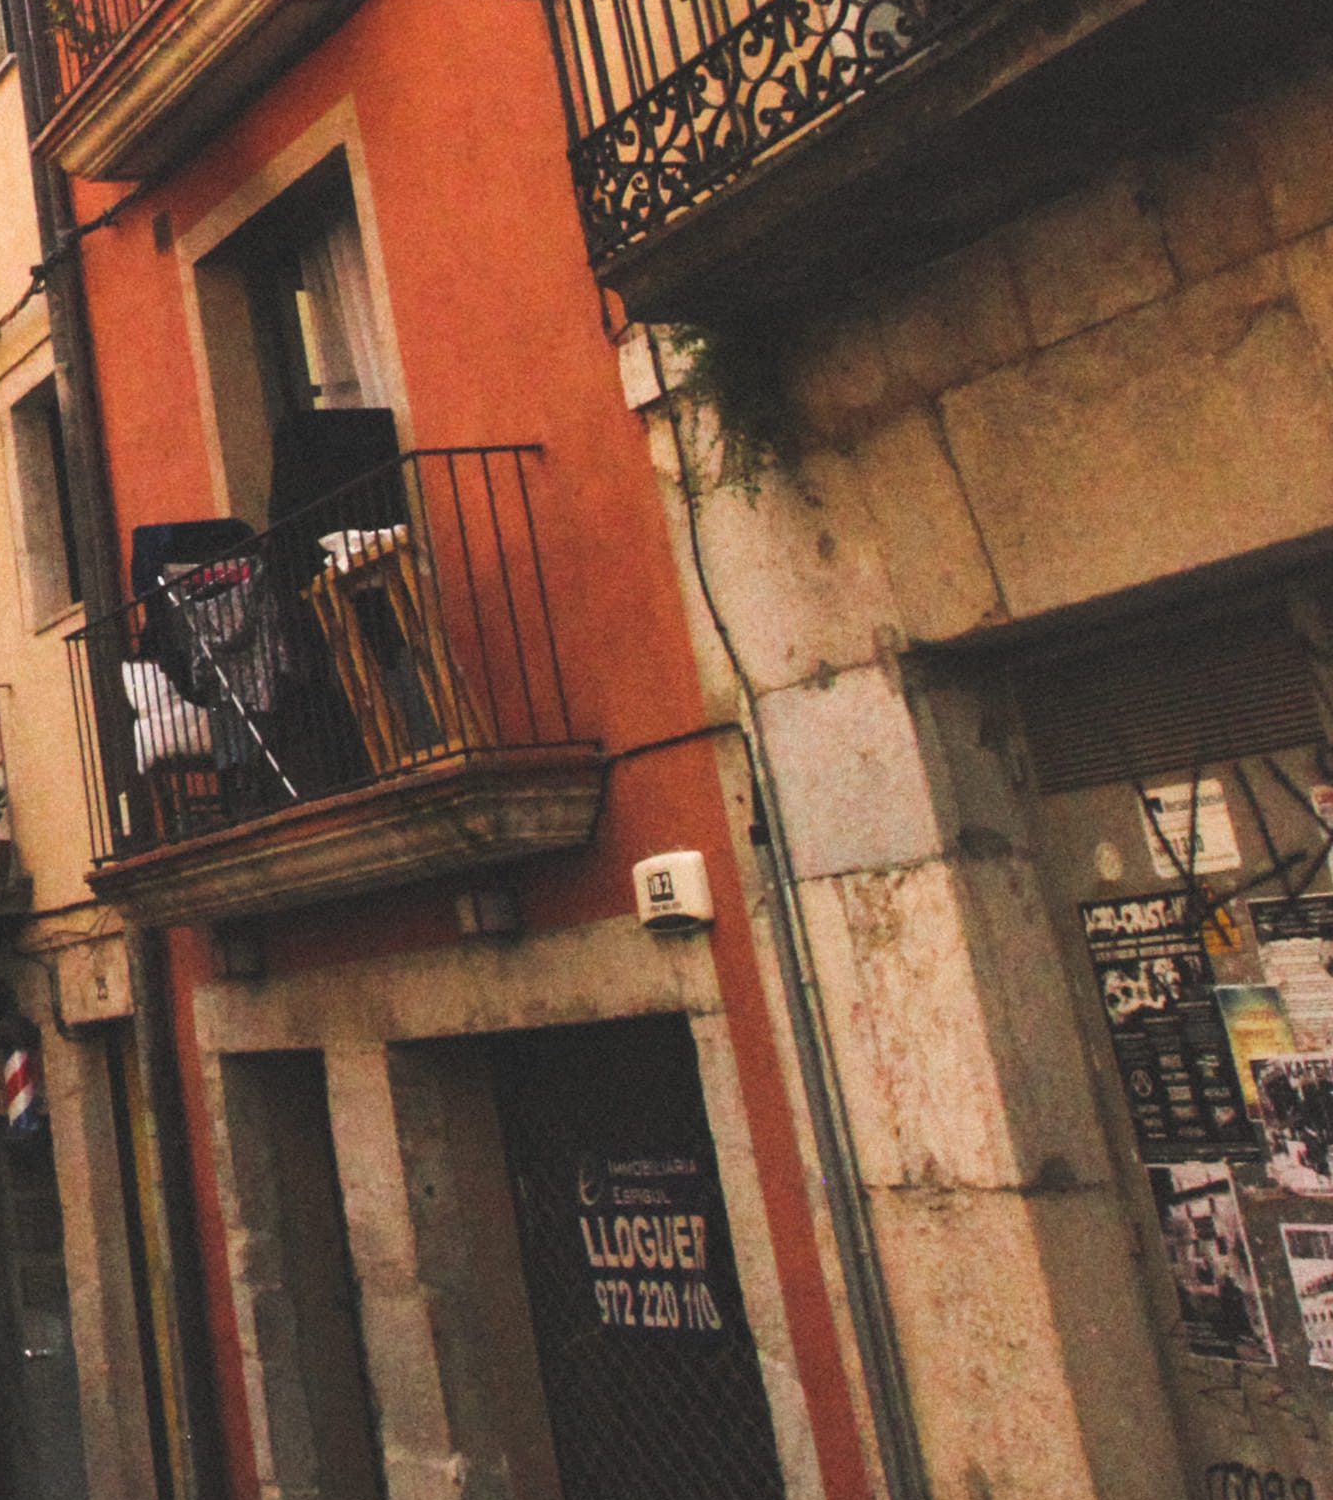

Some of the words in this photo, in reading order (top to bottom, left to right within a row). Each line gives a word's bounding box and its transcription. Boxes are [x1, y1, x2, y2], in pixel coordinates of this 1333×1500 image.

[579, 1215, 707, 1270] LLOGUER
[595, 1280, 636, 1326] 972
[638, 1280, 681, 1328] 220
[681, 1281, 723, 1331] 110
